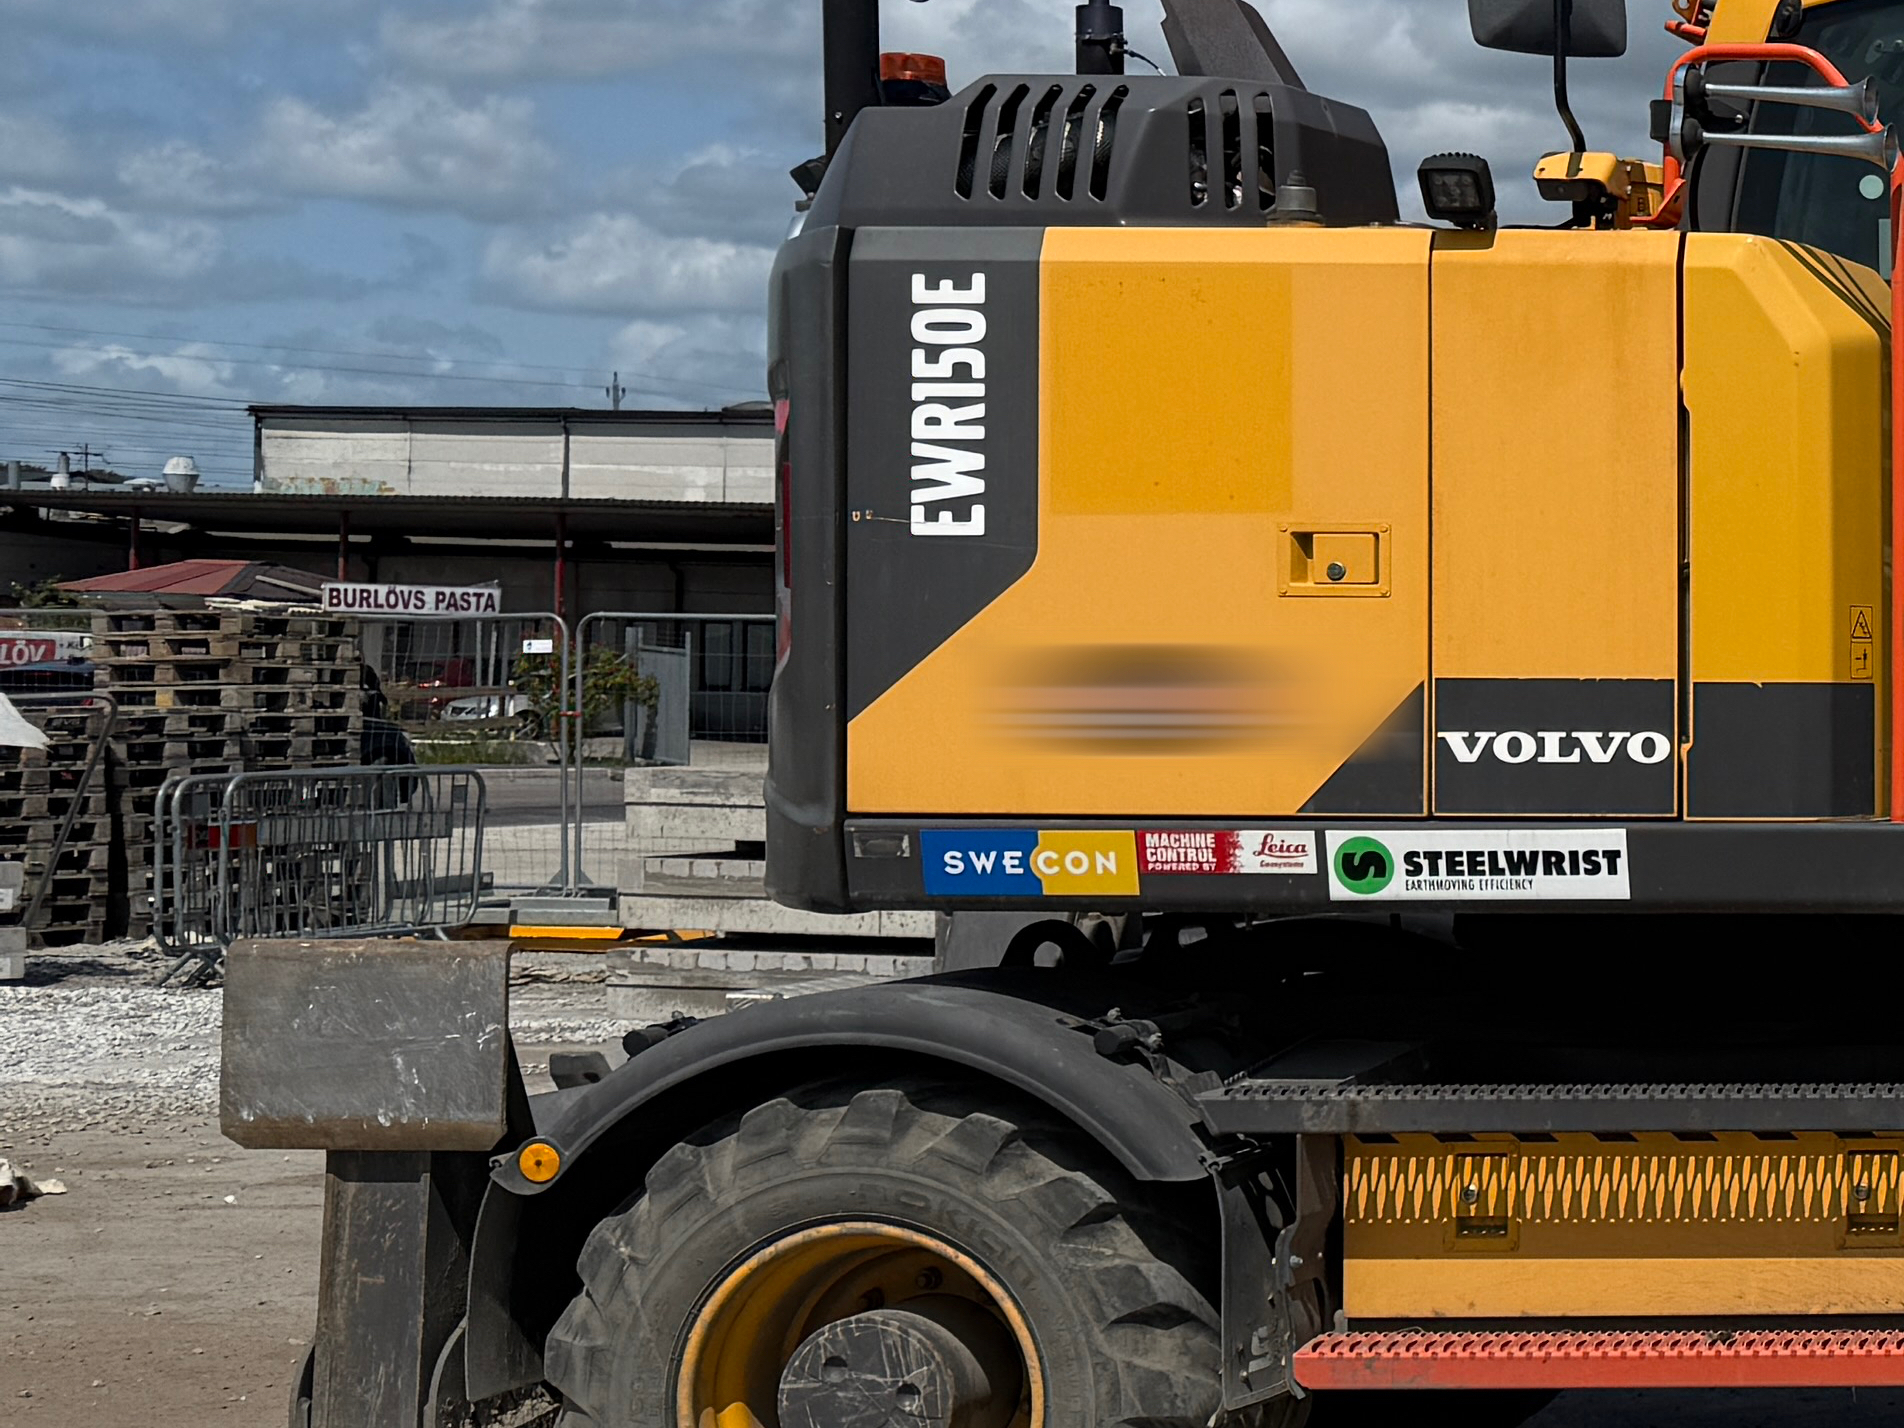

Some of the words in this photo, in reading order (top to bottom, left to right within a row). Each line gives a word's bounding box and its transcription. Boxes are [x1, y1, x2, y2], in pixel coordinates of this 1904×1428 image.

[910, 272, 986, 537] EWR150E
[328, 585, 426, 610] BURLÖVS
[434, 590, 497, 613] PASTA
[1437, 730, 1671, 764] VOLVO
[1145, 833, 1217, 848] MACHINE
[1253, 833, 1309, 858] Leica
[943, 850, 1118, 875] SWECON
[1146, 848, 1217, 863] CONTROL
[1147, 863, 1199, 871] POWERED
[1203, 863, 1217, 871] BY
[1403, 849, 1622, 877] STEELWRIST
[1405, 879, 1475, 892] EARTHMOVING
[1479, 878, 1534, 891] EFFICIENCY
